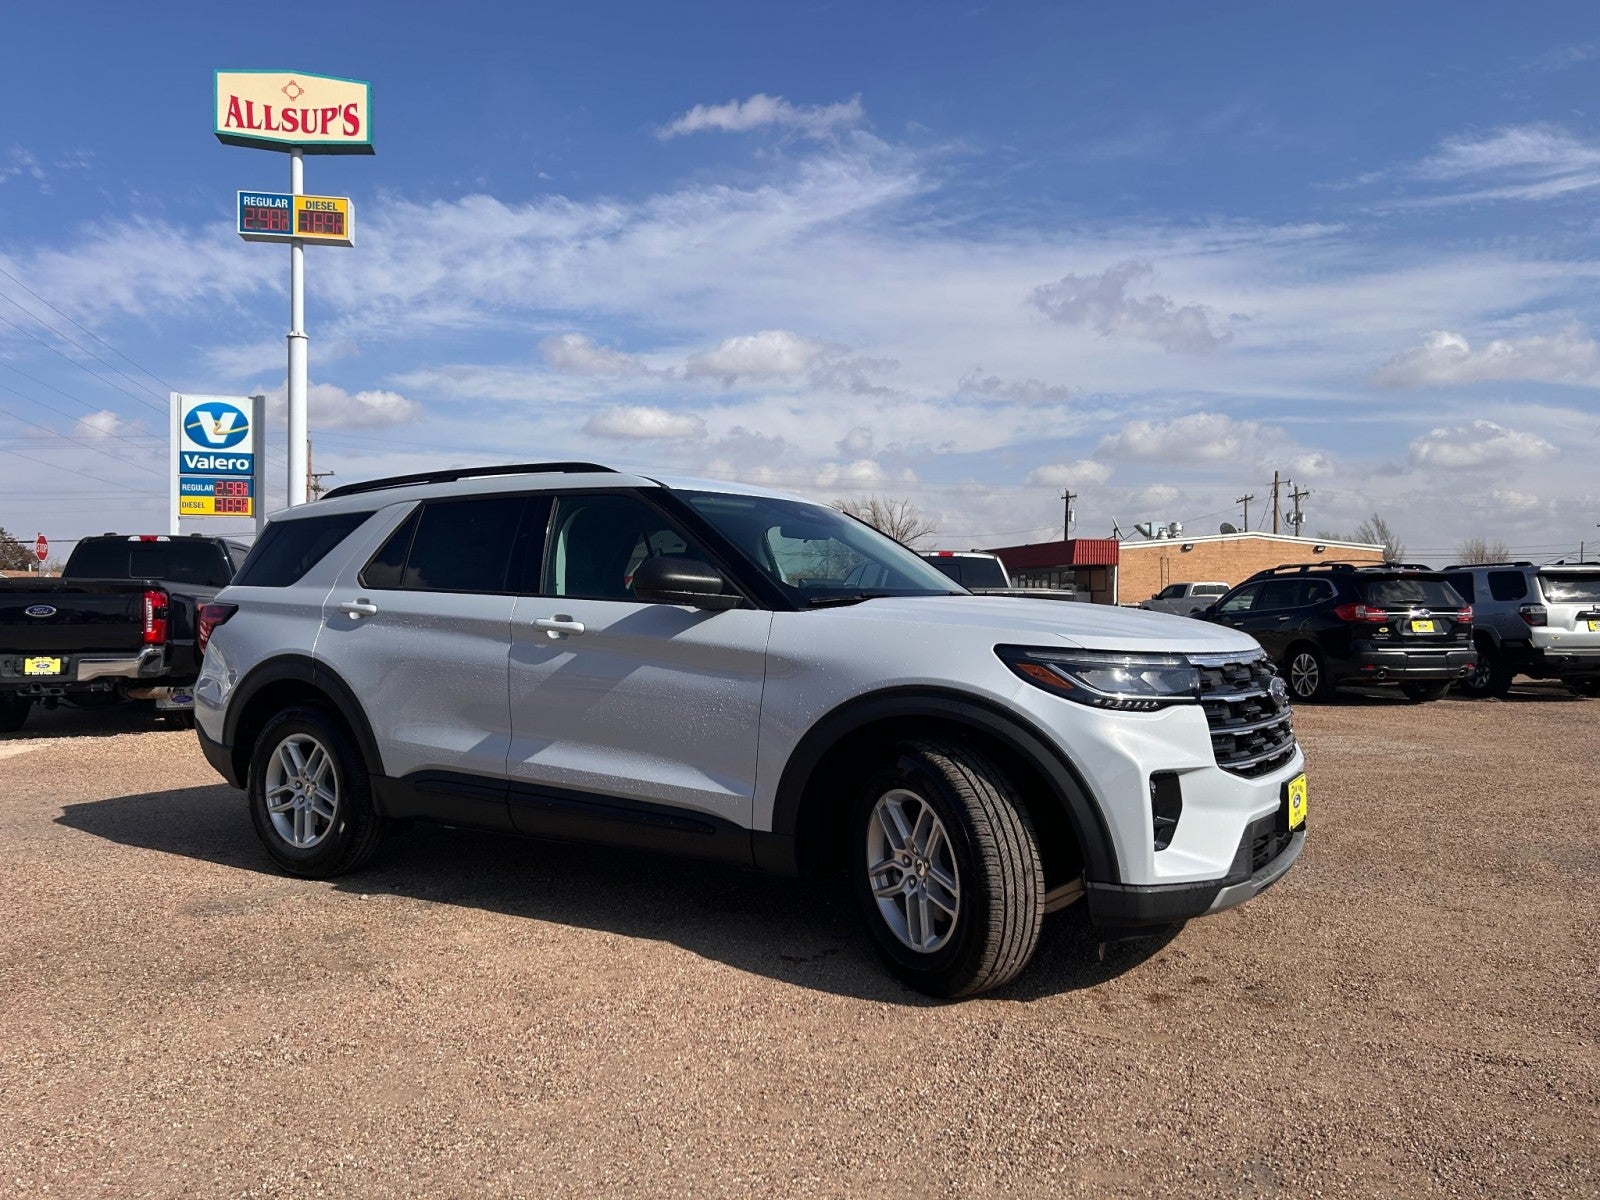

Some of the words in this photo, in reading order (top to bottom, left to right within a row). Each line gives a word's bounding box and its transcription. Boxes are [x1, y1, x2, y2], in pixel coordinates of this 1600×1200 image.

[225, 95, 360, 137] ALLSUP'S
[243, 196, 288, 208] REGULAR
[305, 201, 338, 211] DIESEL
[184, 454, 249, 470] Valero
[36, 543, 47, 553] STOP
